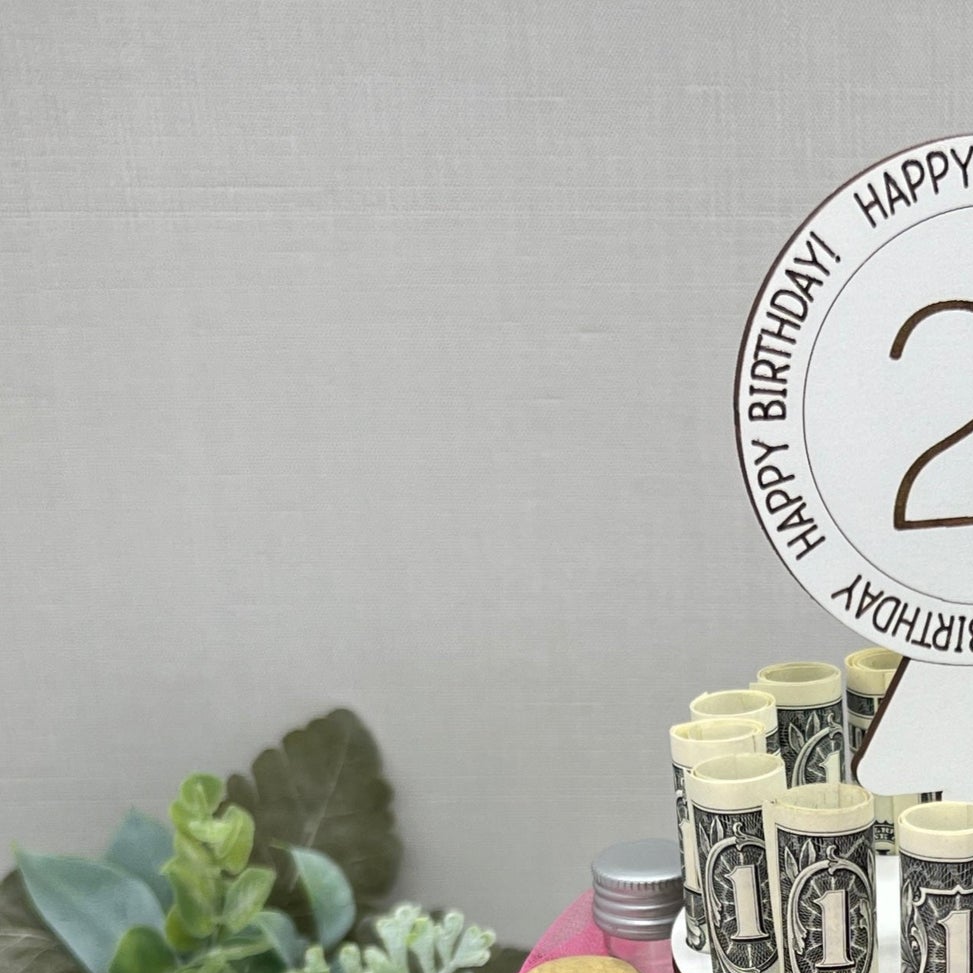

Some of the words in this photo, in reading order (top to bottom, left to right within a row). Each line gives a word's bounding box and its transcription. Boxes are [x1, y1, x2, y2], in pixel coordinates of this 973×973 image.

[748, 231, 842, 422] BIRTHDAY!
[753, 438, 827, 560] HAPPY
[724, 864, 769, 940] 1
[813, 889, 855, 969] 1
